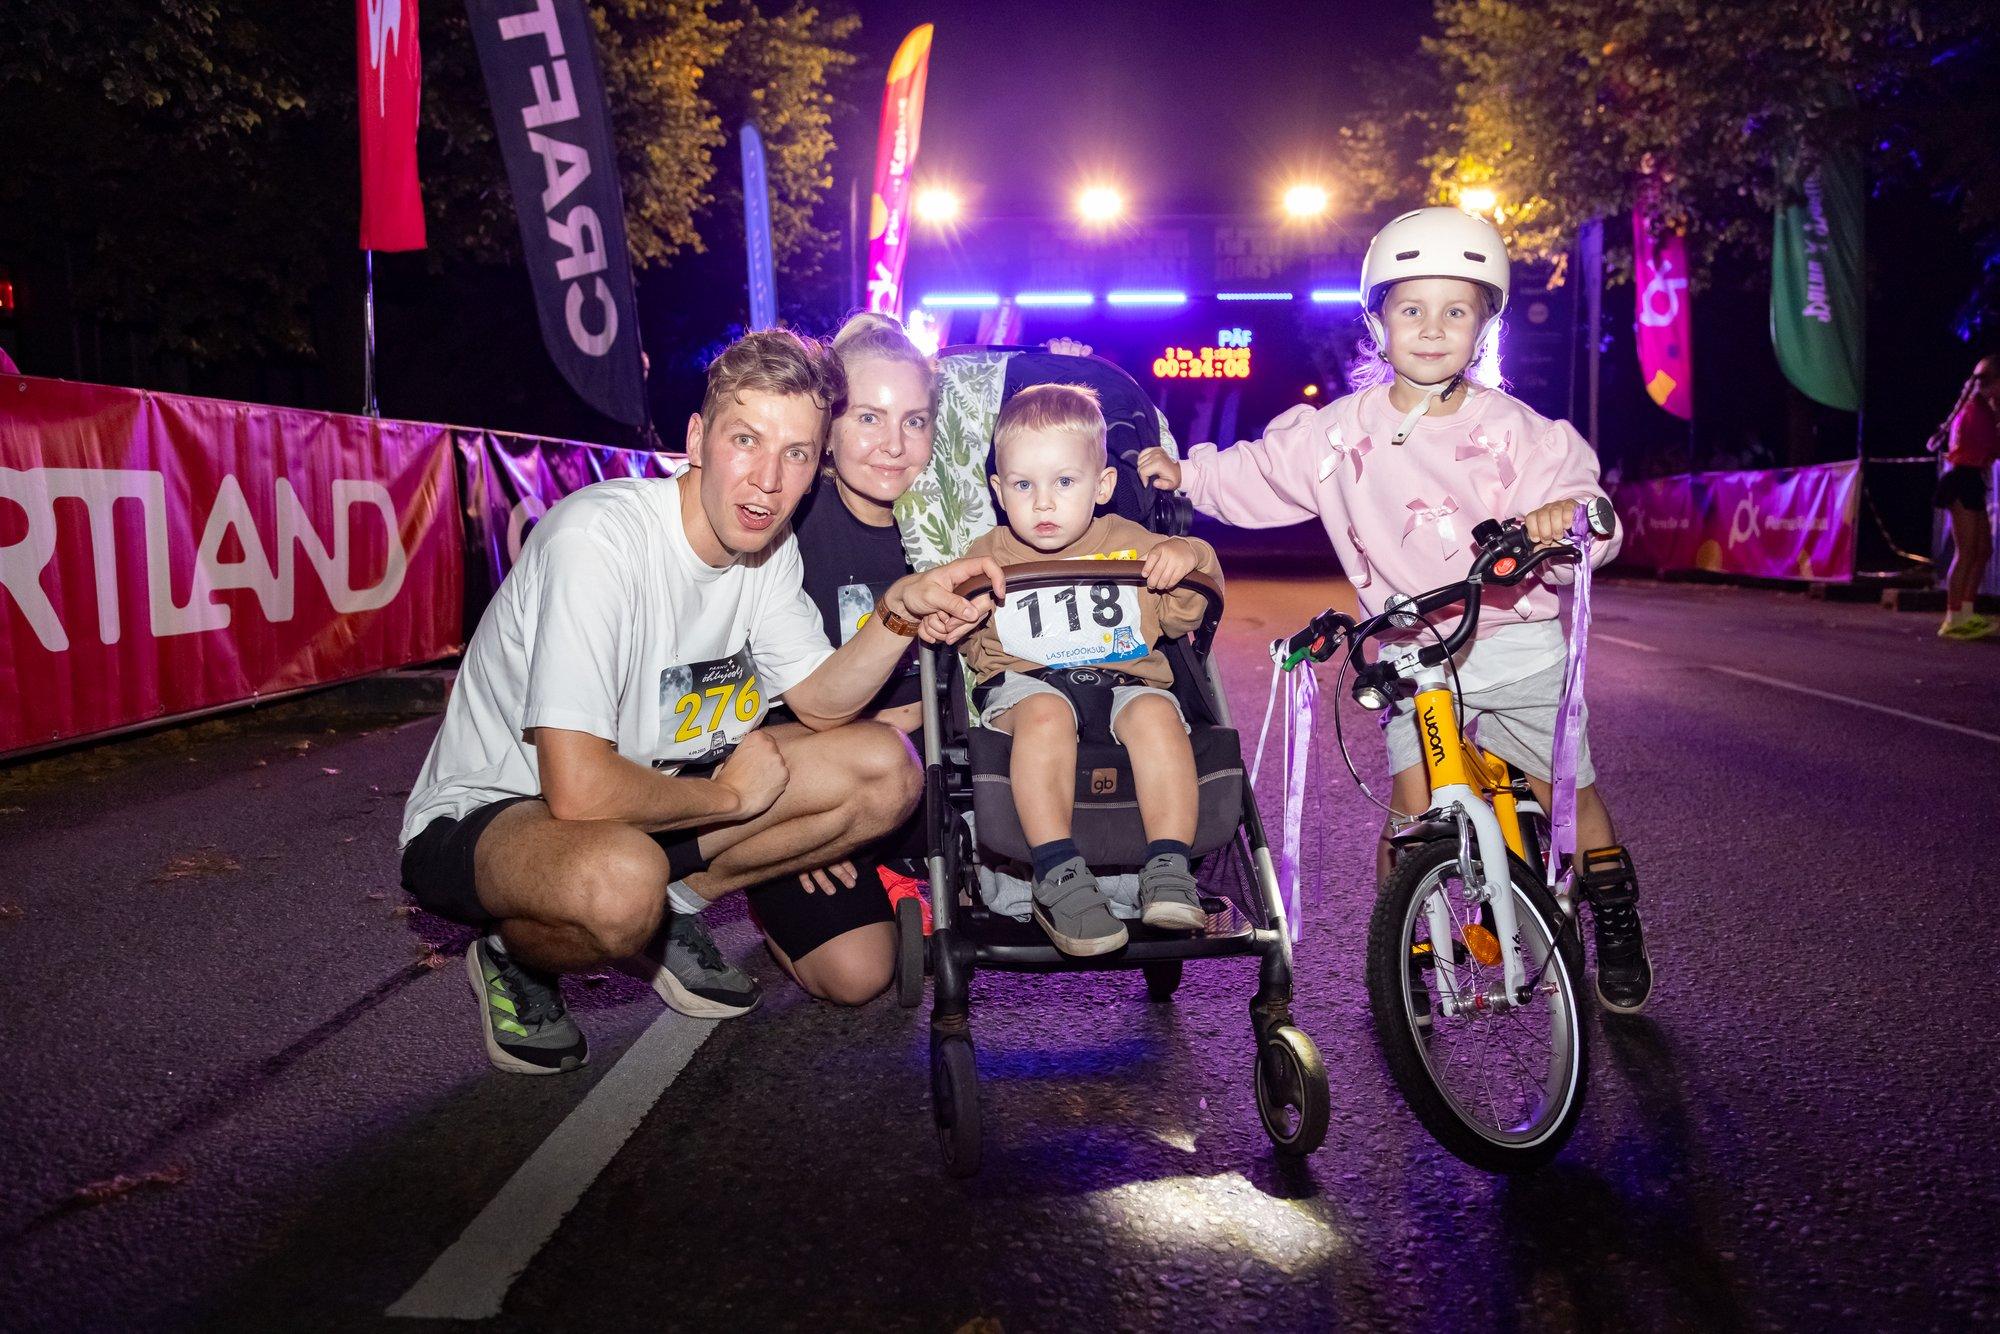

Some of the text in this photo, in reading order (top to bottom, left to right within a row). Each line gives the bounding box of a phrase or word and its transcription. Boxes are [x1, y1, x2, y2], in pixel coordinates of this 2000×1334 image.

[1016, 581, 1124, 639] 118
[1046, 645, 1106, 660] LASTEJOOKSUD
[1077, 674, 1095, 682] gb
[674, 675, 761, 743] 276
[1423, 706, 1445, 767] woom
[1093, 776, 1114, 793] gb
